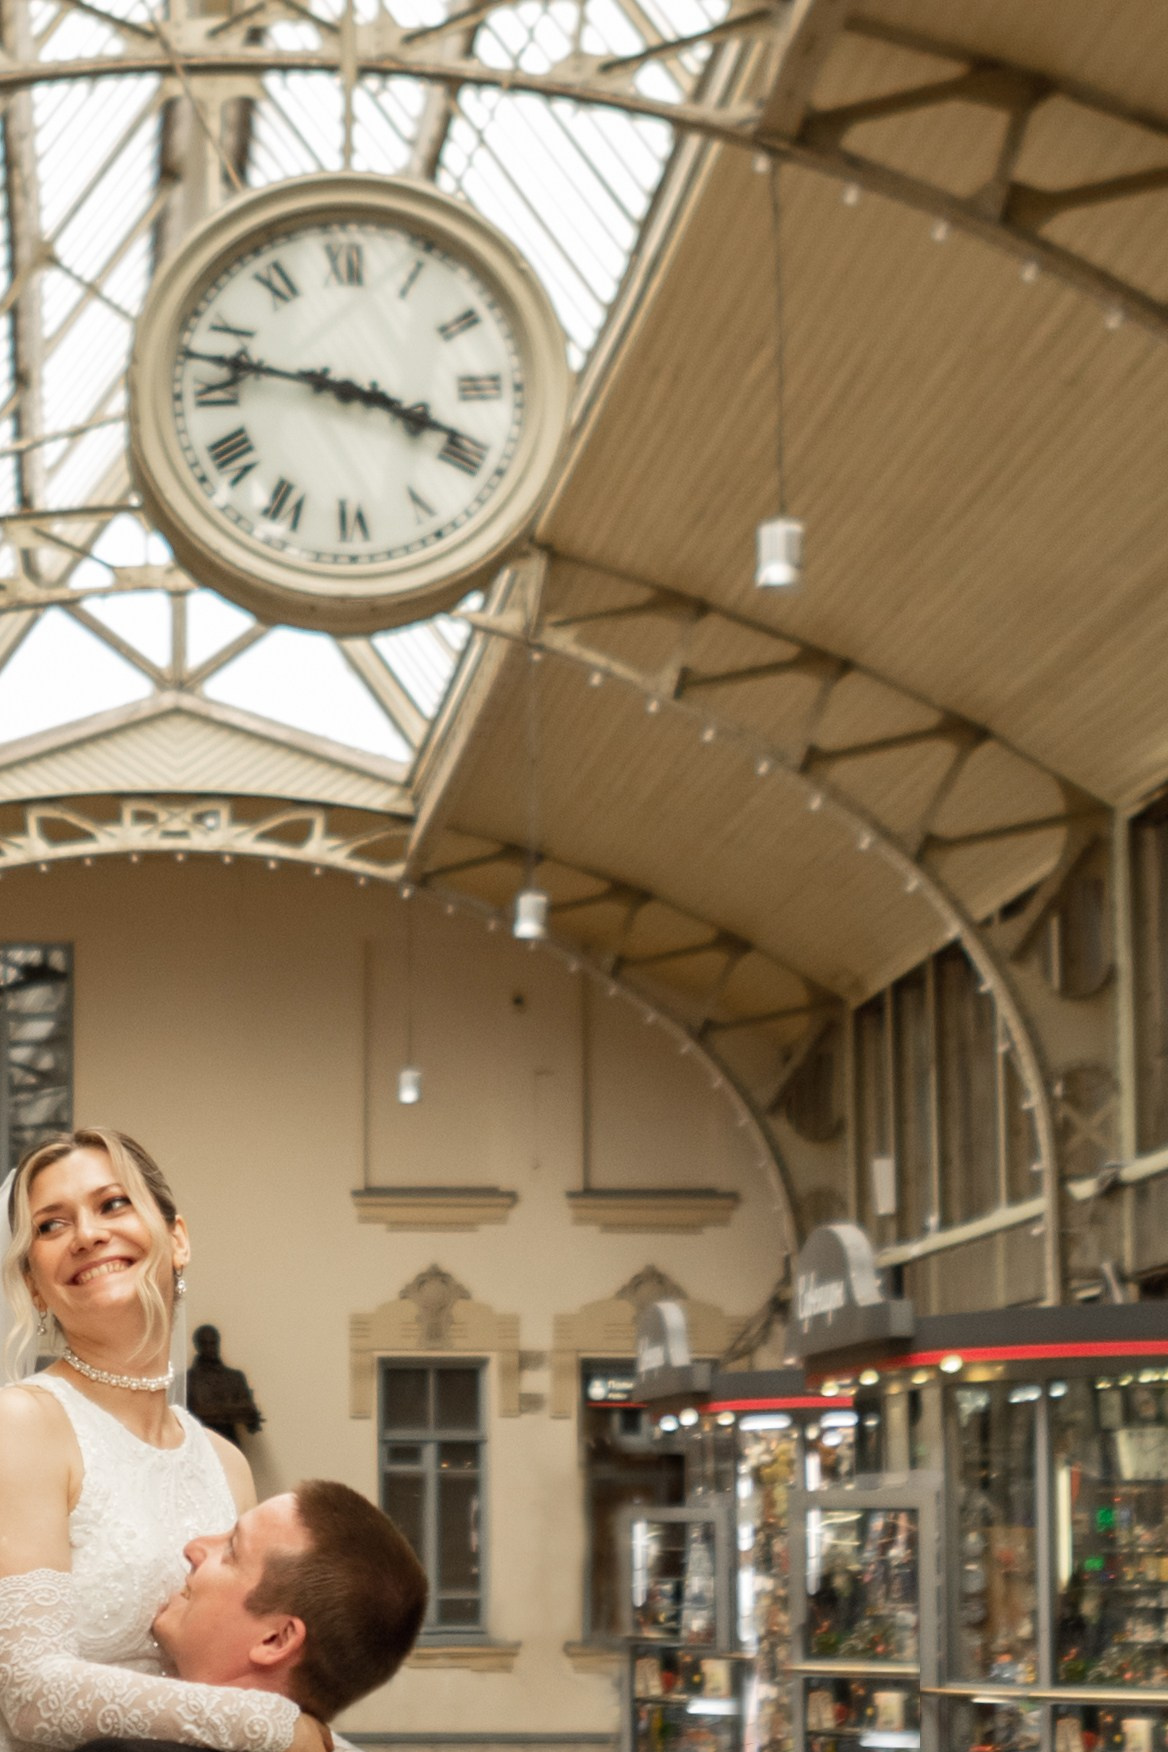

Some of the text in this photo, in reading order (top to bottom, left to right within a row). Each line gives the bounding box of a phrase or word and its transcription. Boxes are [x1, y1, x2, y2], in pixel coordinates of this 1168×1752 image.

[253, 260, 298, 311] XI
[325, 243, 363, 287] XII
[209, 312, 256, 345] X
[438, 308, 481, 342] II
[458, 373, 501, 401] III
[207, 426, 261, 487] VIII
[262, 478, 306, 532] VII
[338, 500, 370, 542] VI
[407, 485, 436, 524] V
